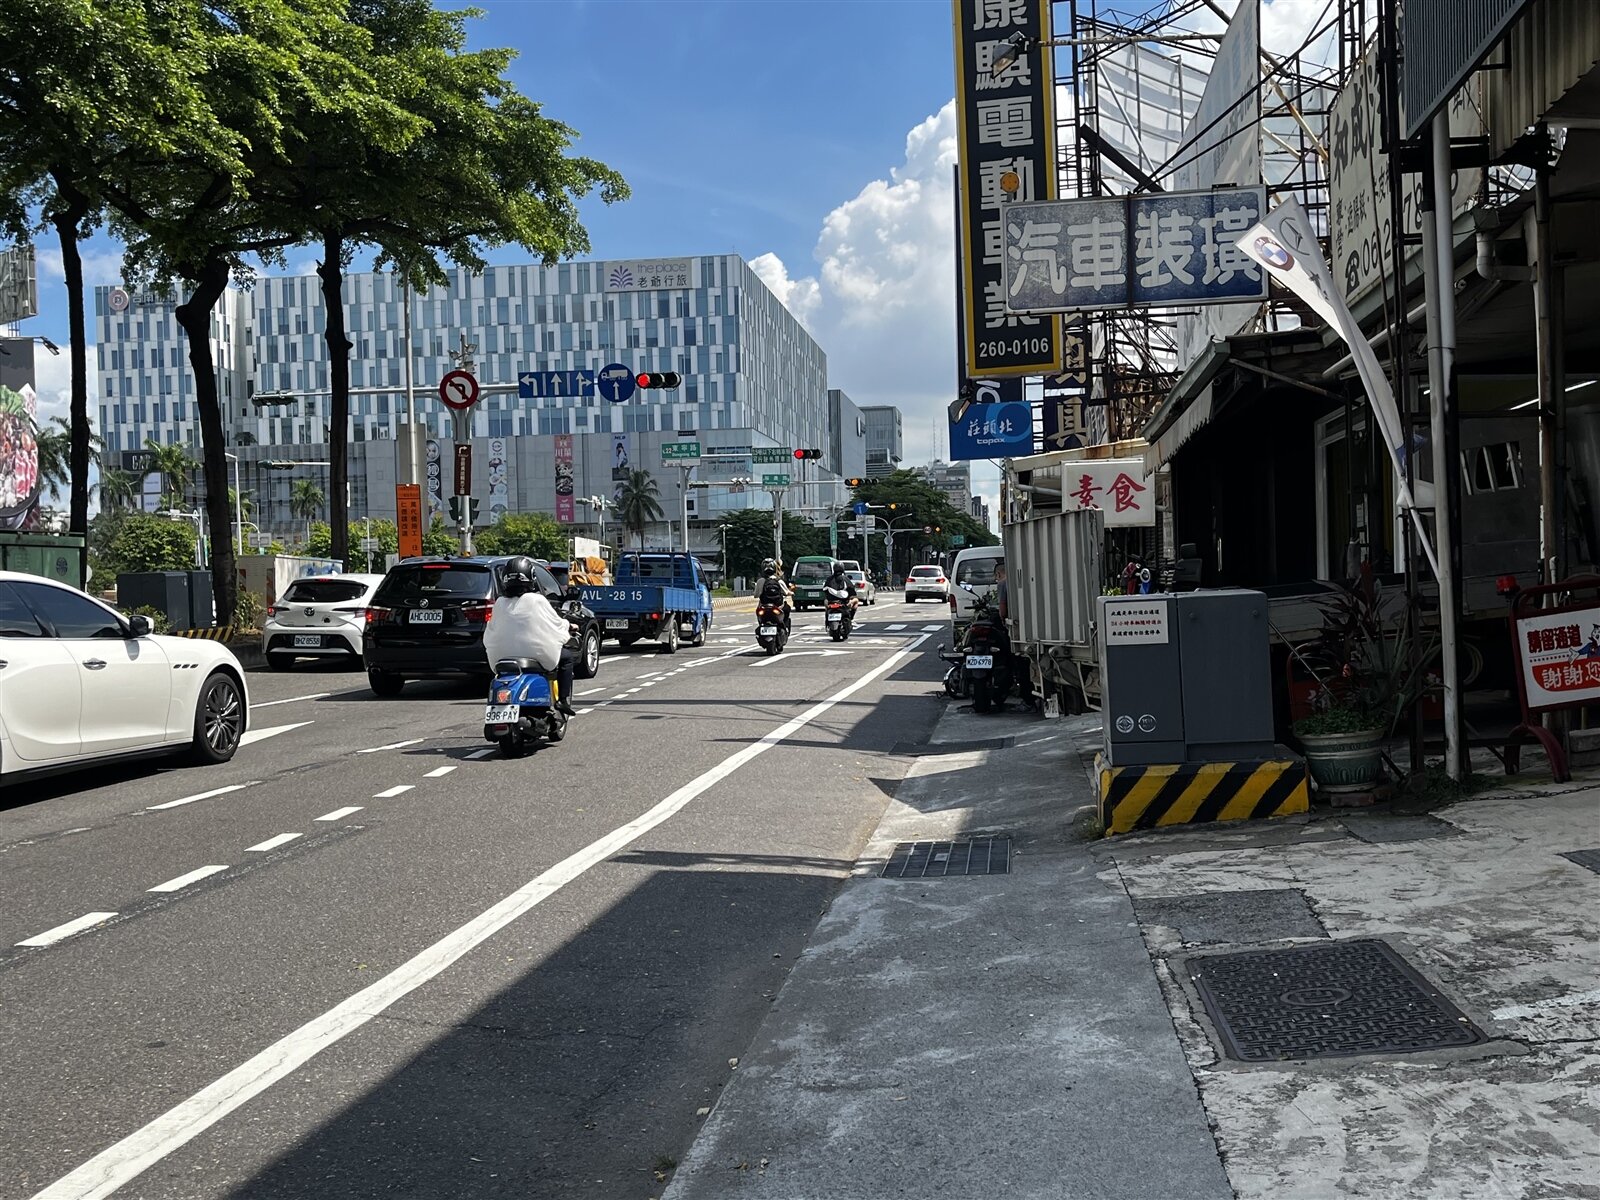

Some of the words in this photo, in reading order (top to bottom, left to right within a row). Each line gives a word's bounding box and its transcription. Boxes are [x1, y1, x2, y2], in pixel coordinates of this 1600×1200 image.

[637, 263, 655, 274] the
[656, 262, 687, 275] place
[637, 274, 687, 288] 老爺行旅
[979, 337, 1049, 358] 260-0106
[968, 418, 1013, 437] 莊頭北
[976, 438, 1006, 446] topax
[131, 455, 151, 470] GAP
[1069, 472, 1147, 512] 素食
[581, 590, 602, 601] AVL
[631, 590, 643, 601] 15
[1527, 624, 1582, 653] 請留通道
[1542, 661, 1600, 689] 謝謝您
